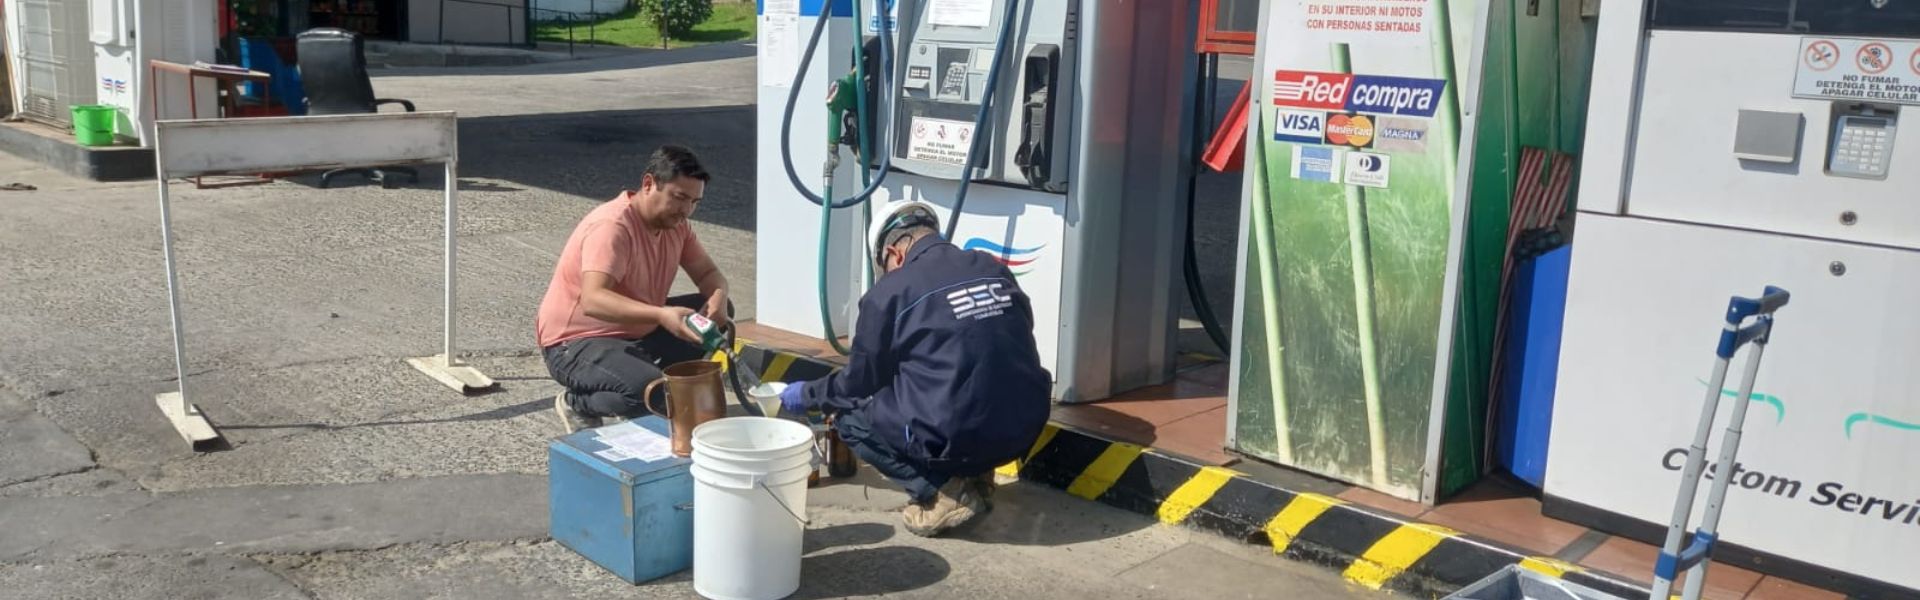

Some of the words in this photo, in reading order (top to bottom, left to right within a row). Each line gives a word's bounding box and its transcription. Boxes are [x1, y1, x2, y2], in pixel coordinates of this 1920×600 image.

[1308, 4, 1319, 14] EN
[1322, 5, 1333, 15] SU
[1335, 5, 1376, 16] INTERIOR
[1379, 6, 1387, 16] NI
[1391, 7, 1423, 17] MOTOS
[1307, 19, 1324, 29] CON
[1326, 20, 1372, 31] PERSONAS
[1375, 21, 1421, 32] SENTADAS
[1861, 75, 1900, 84] FUMAR
[1816, 81, 1865, 90] DETENGA
[1869, 83, 1882, 91] EL
[1885, 84, 1920, 93] MOTO
[1300, 75, 1349, 104] Red
[1352, 82, 1433, 115] compra
[1821, 88, 1864, 97] APAGAR
[1867, 91, 1918, 100] CELULAR
[1280, 112, 1320, 131] VISA
[1327, 123, 1373, 138] MasterCard
[1383, 128, 1419, 140] MAGNA
[946, 283, 1011, 313] SEC
[1809, 481, 1920, 526] Servi
